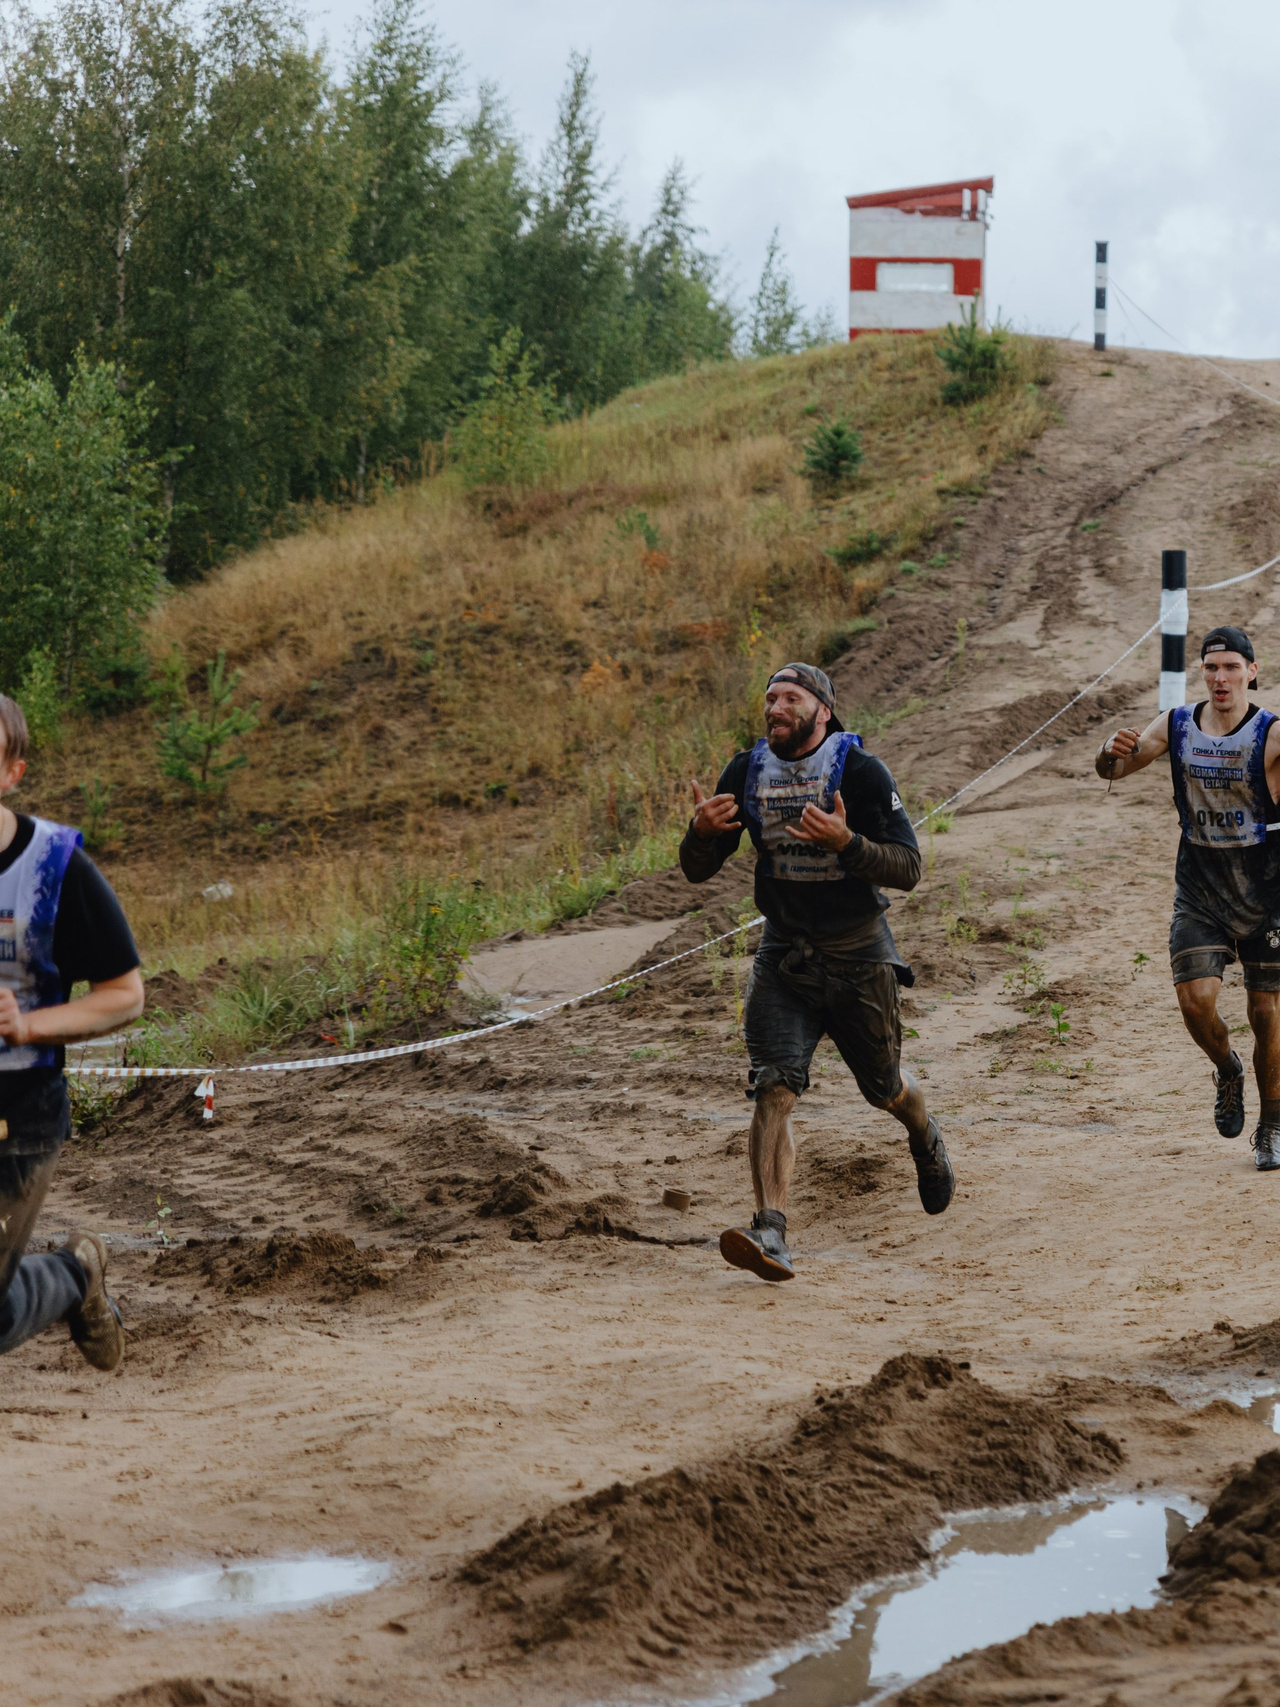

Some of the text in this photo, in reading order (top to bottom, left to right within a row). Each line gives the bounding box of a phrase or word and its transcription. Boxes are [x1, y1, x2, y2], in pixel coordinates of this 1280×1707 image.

[1192, 747, 1242, 758] ГОНКА ГЕРОЕВ
[1197, 810, 1244, 828] 01209
